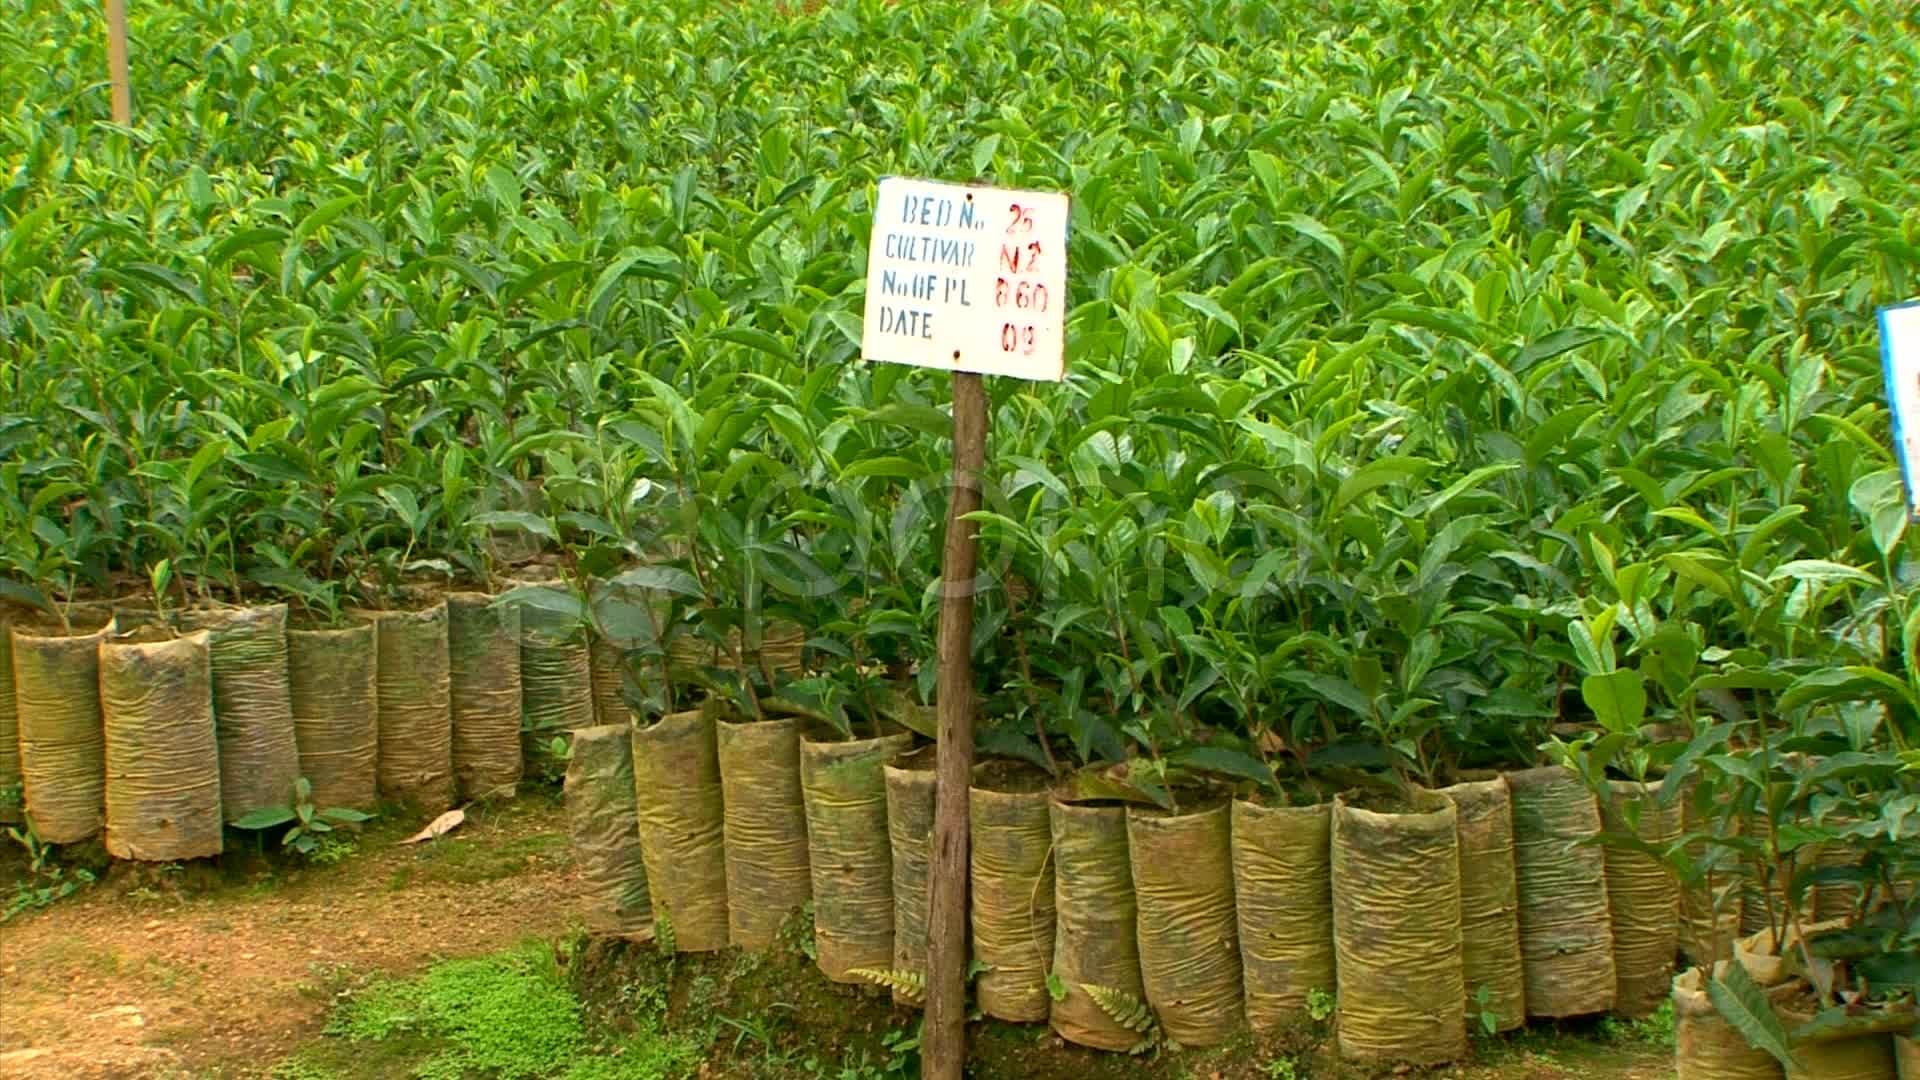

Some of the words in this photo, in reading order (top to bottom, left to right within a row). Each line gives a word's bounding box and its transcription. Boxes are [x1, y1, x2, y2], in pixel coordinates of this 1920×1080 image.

[902, 194, 952, 226] BED
[885, 233, 975, 267] CULTIVAR
[879, 305, 933, 339] DATE
